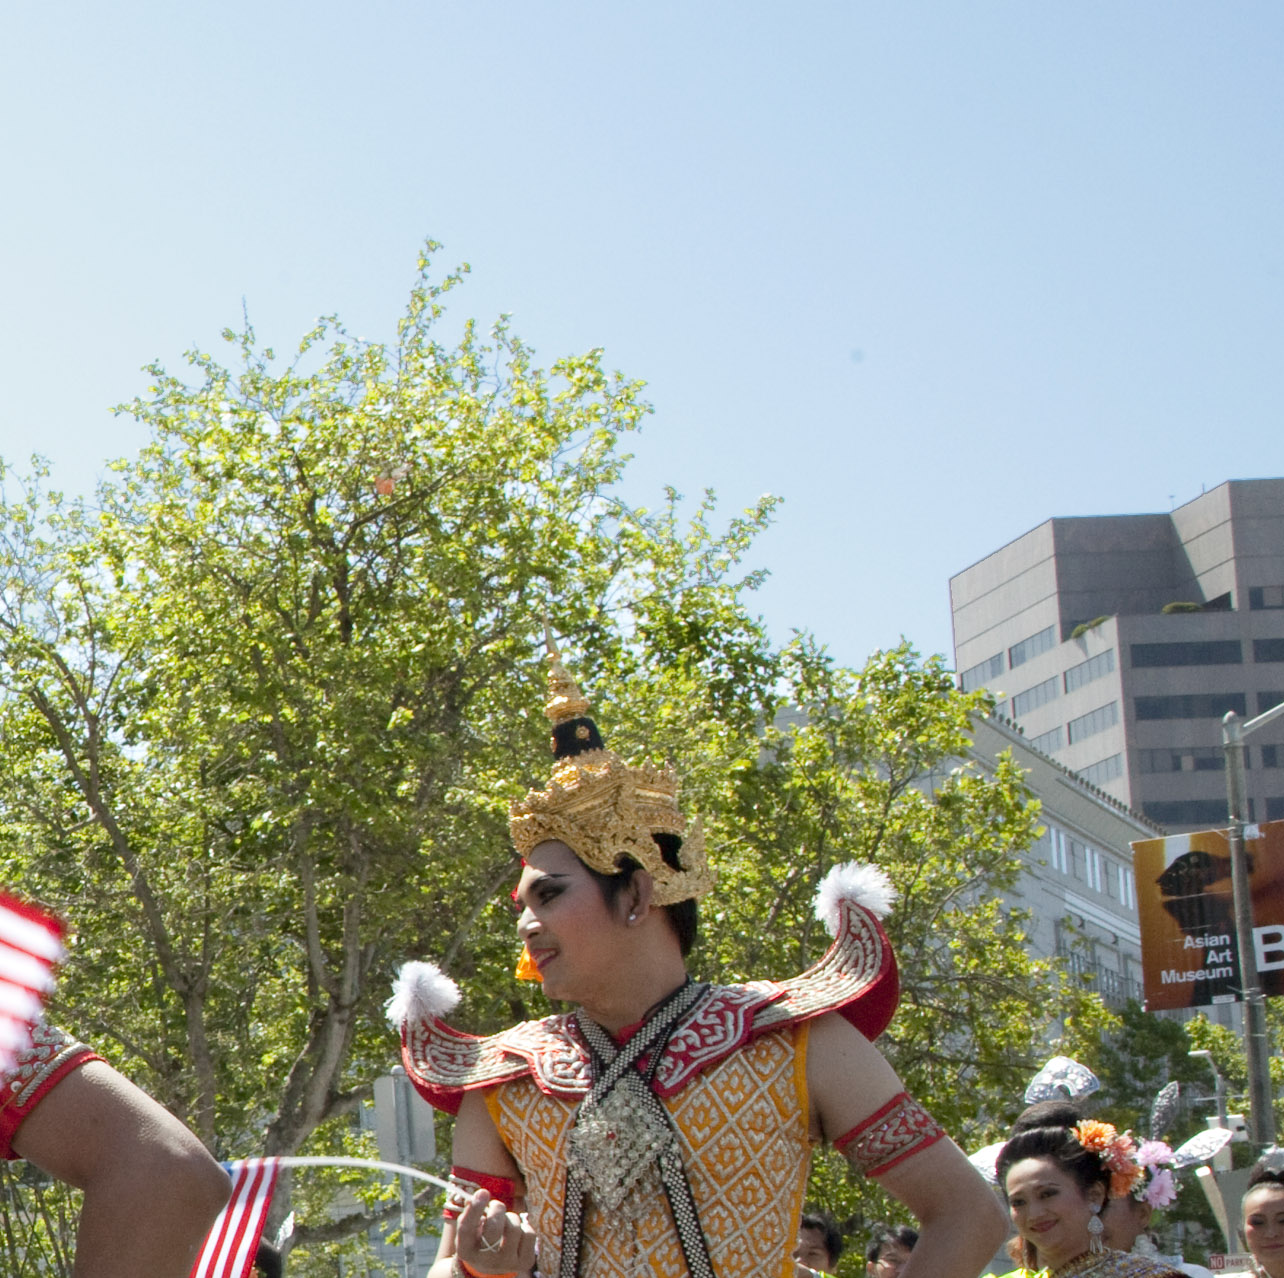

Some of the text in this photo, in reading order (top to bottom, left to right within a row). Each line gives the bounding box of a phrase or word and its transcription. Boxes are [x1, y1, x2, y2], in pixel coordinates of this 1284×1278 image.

[1183, 933, 1230, 951] Asian
[1206, 949, 1233, 964] Art
[1161, 966, 1233, 985] Museum
[1210, 1257, 1223, 1269] NO
